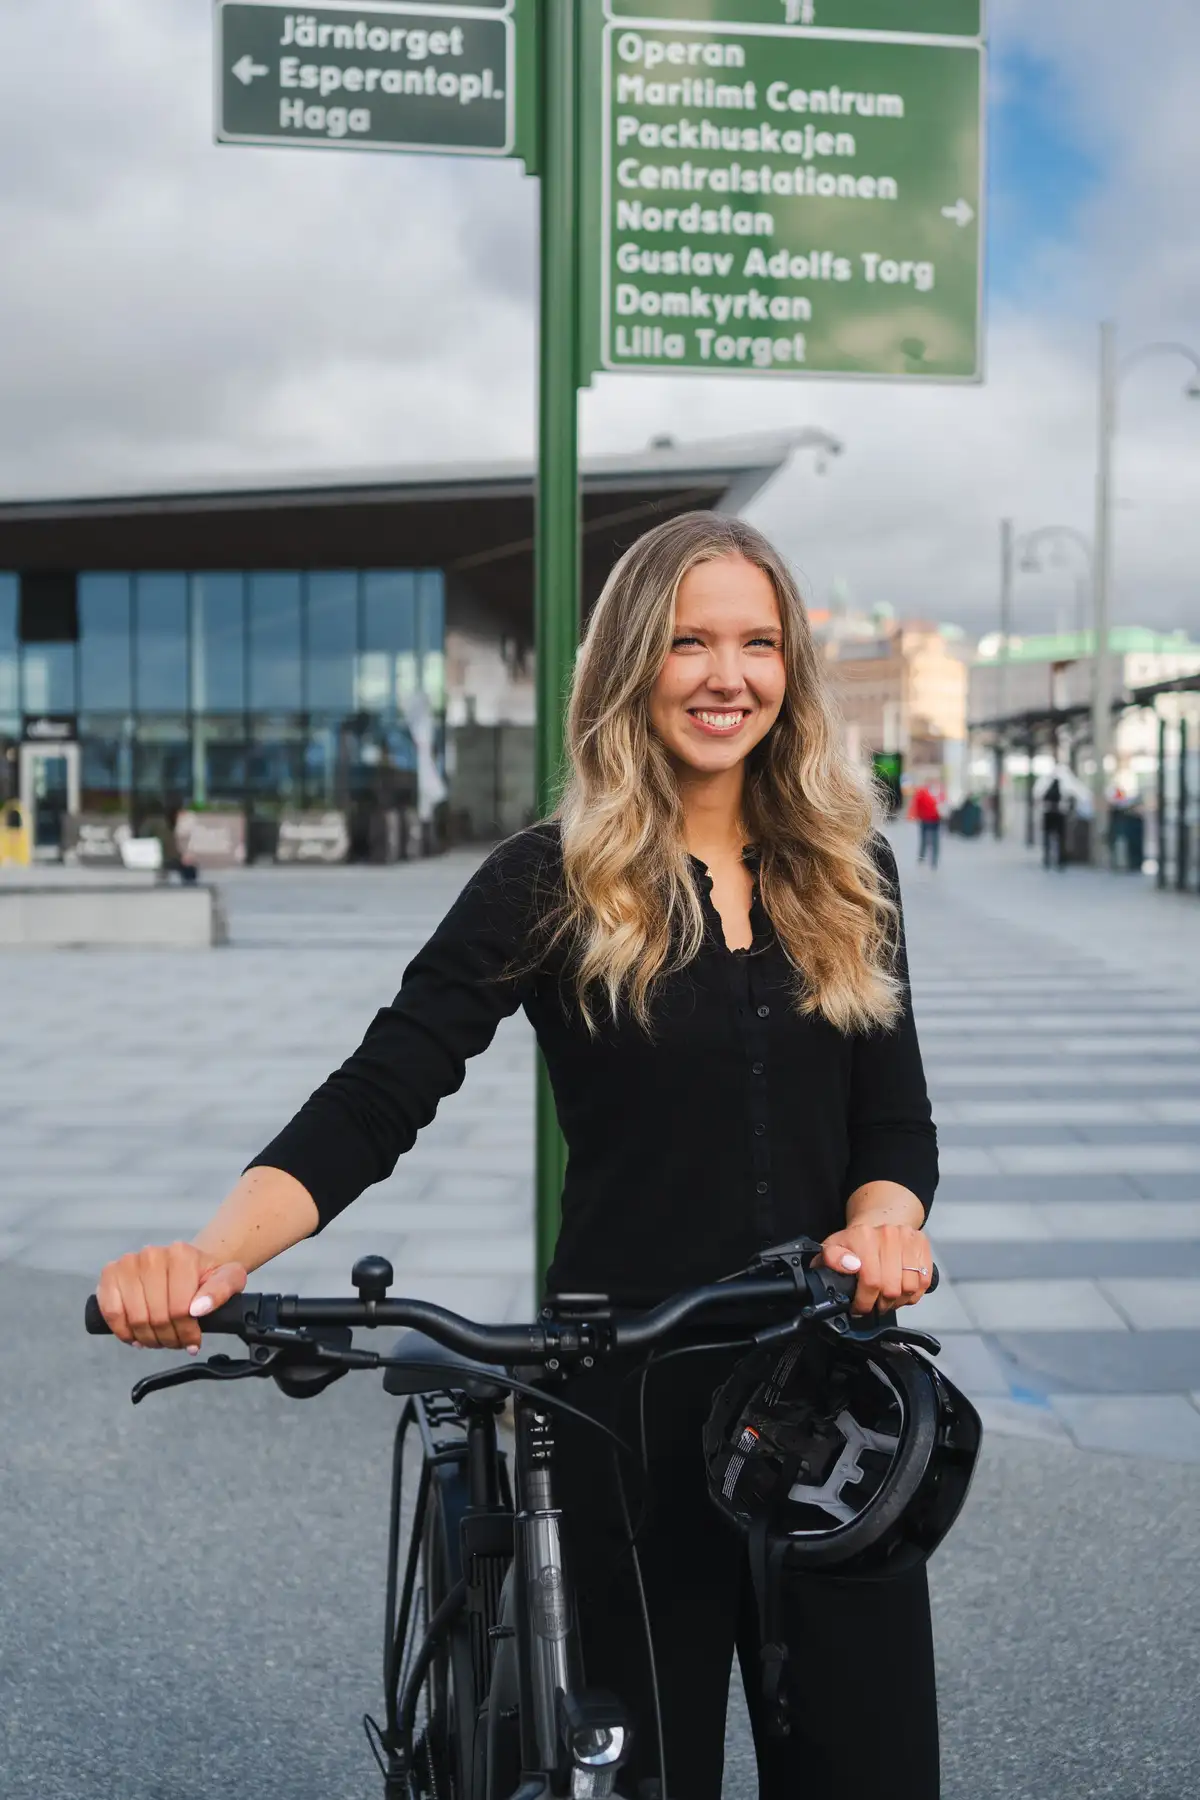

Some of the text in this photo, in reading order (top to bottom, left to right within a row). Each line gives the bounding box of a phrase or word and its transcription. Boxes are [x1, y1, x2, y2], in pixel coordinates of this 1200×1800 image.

[280, 15, 464, 60] Järntorget
[617, 32, 746, 69] Operan
[279, 56, 505, 105] Esperantopl.
[616, 74, 905, 118] Maritimt Centrum
[279, 97, 371, 138] Haga
[616, 116, 857, 160] Packhuskajen
[616, 158, 898, 200] Centralstationen
[616, 200, 775, 237] Nordstan
[616, 242, 935, 292] Gustav Adolfs Torg
[615, 284, 812, 325] Domkyrkan
[615, 325, 806, 368] Lilla Torget
